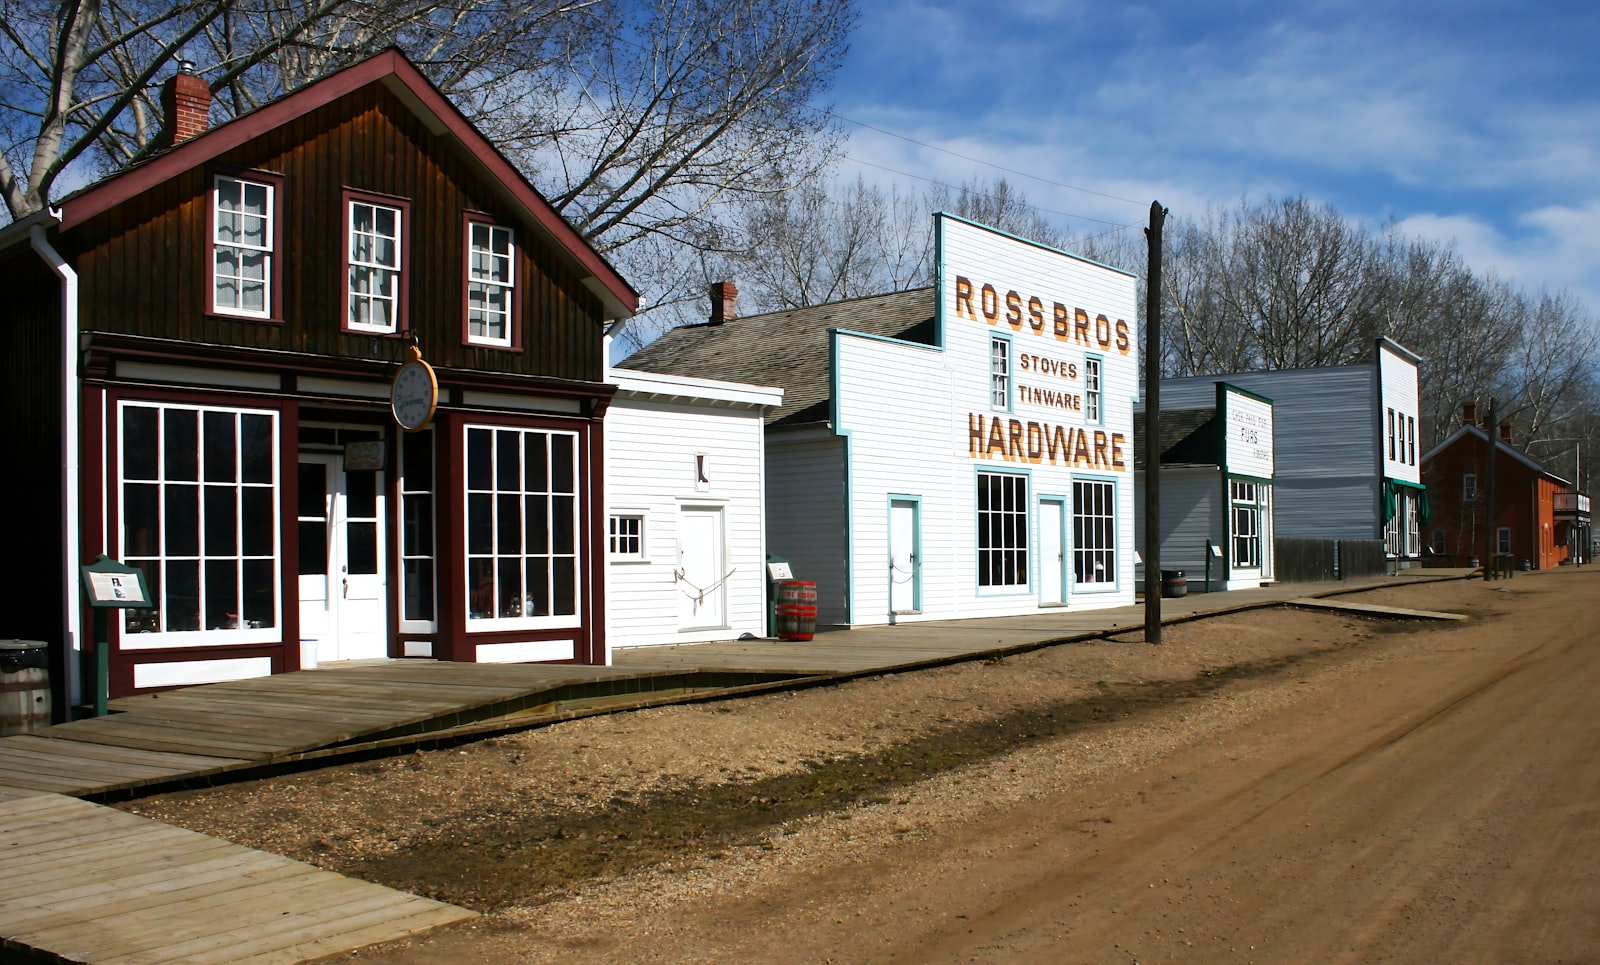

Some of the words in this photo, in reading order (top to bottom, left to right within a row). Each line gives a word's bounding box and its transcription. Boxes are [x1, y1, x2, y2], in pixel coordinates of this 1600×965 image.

[956, 275, 1045, 336] ROSS
[1053, 302, 1130, 356] BROS
[1020, 353, 1077, 380] STOVES
[1018, 385, 1081, 411] TINWARE
[968, 412, 1126, 472] HARDWARE
[1241, 428, 1257, 444] FURS
